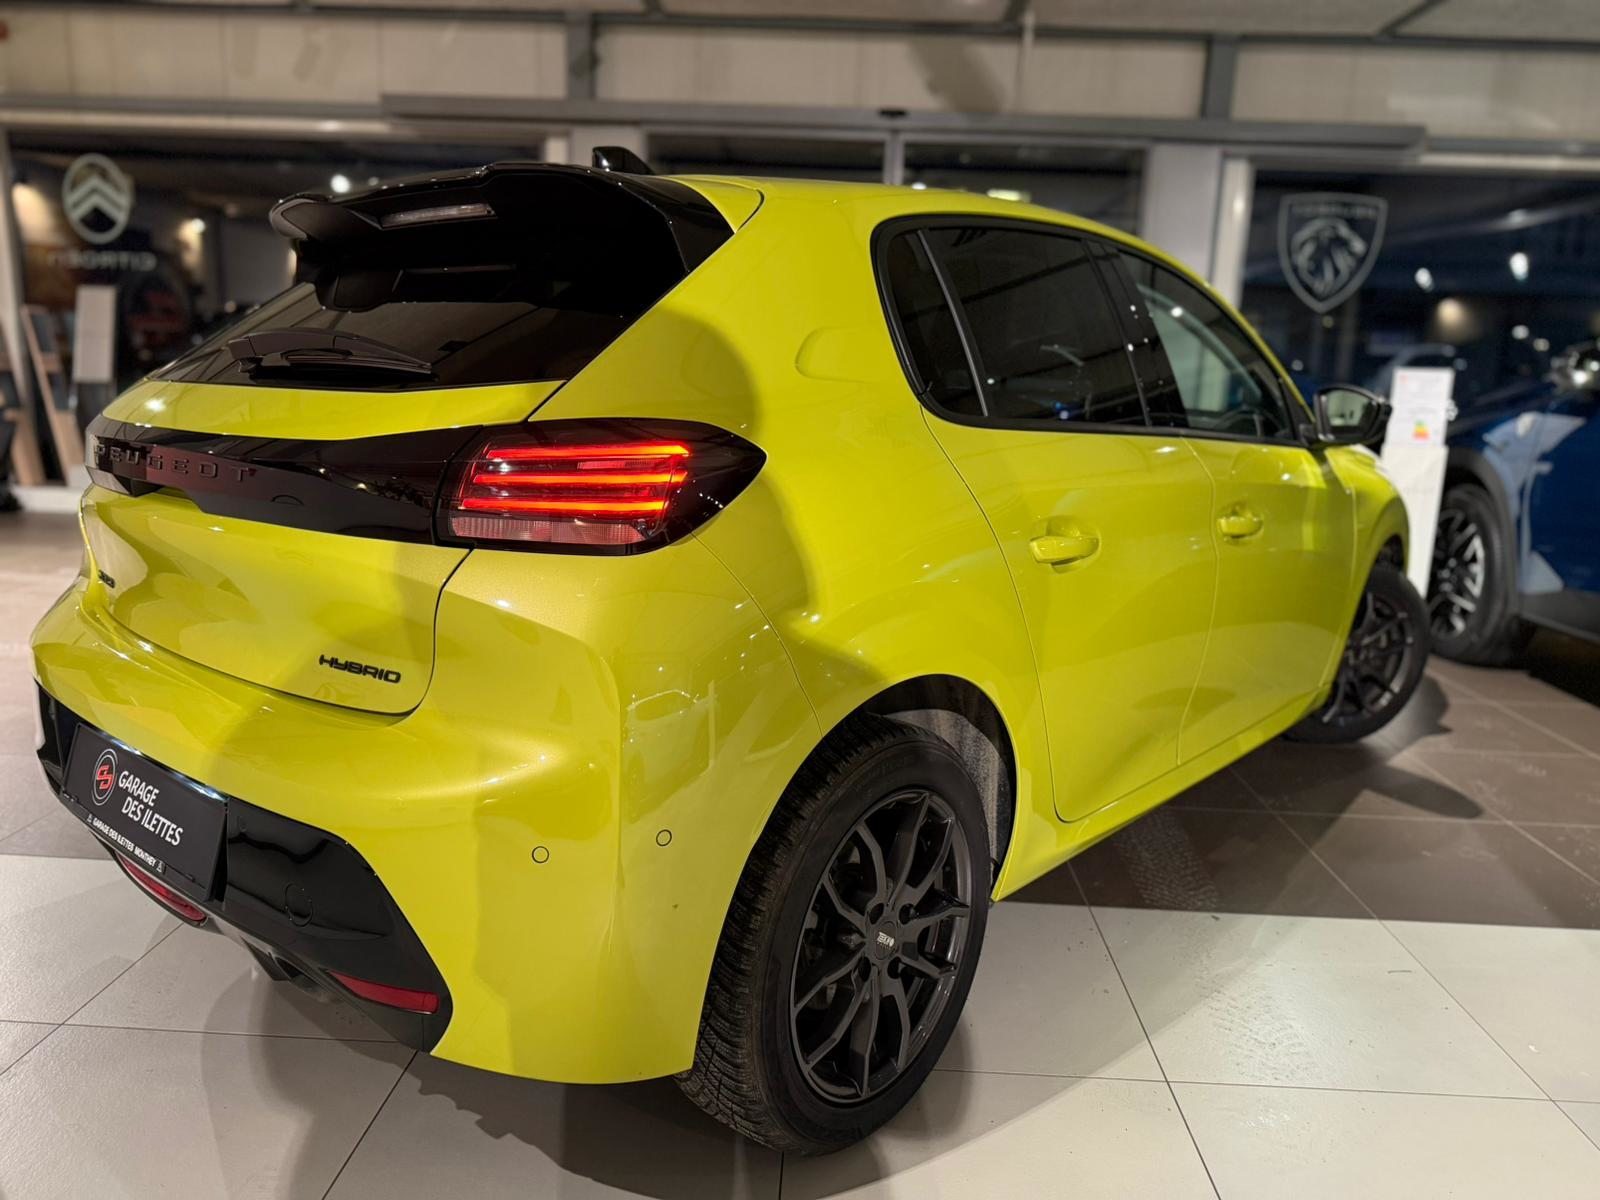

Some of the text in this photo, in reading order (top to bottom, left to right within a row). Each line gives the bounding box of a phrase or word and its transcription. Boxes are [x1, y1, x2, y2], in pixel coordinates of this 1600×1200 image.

[95, 443, 254, 482] PEUGEOT
[319, 654, 402, 684] HYBRID
[118, 770, 160, 807] GARAGE
[121, 797, 184, 846] DES ILETTES
